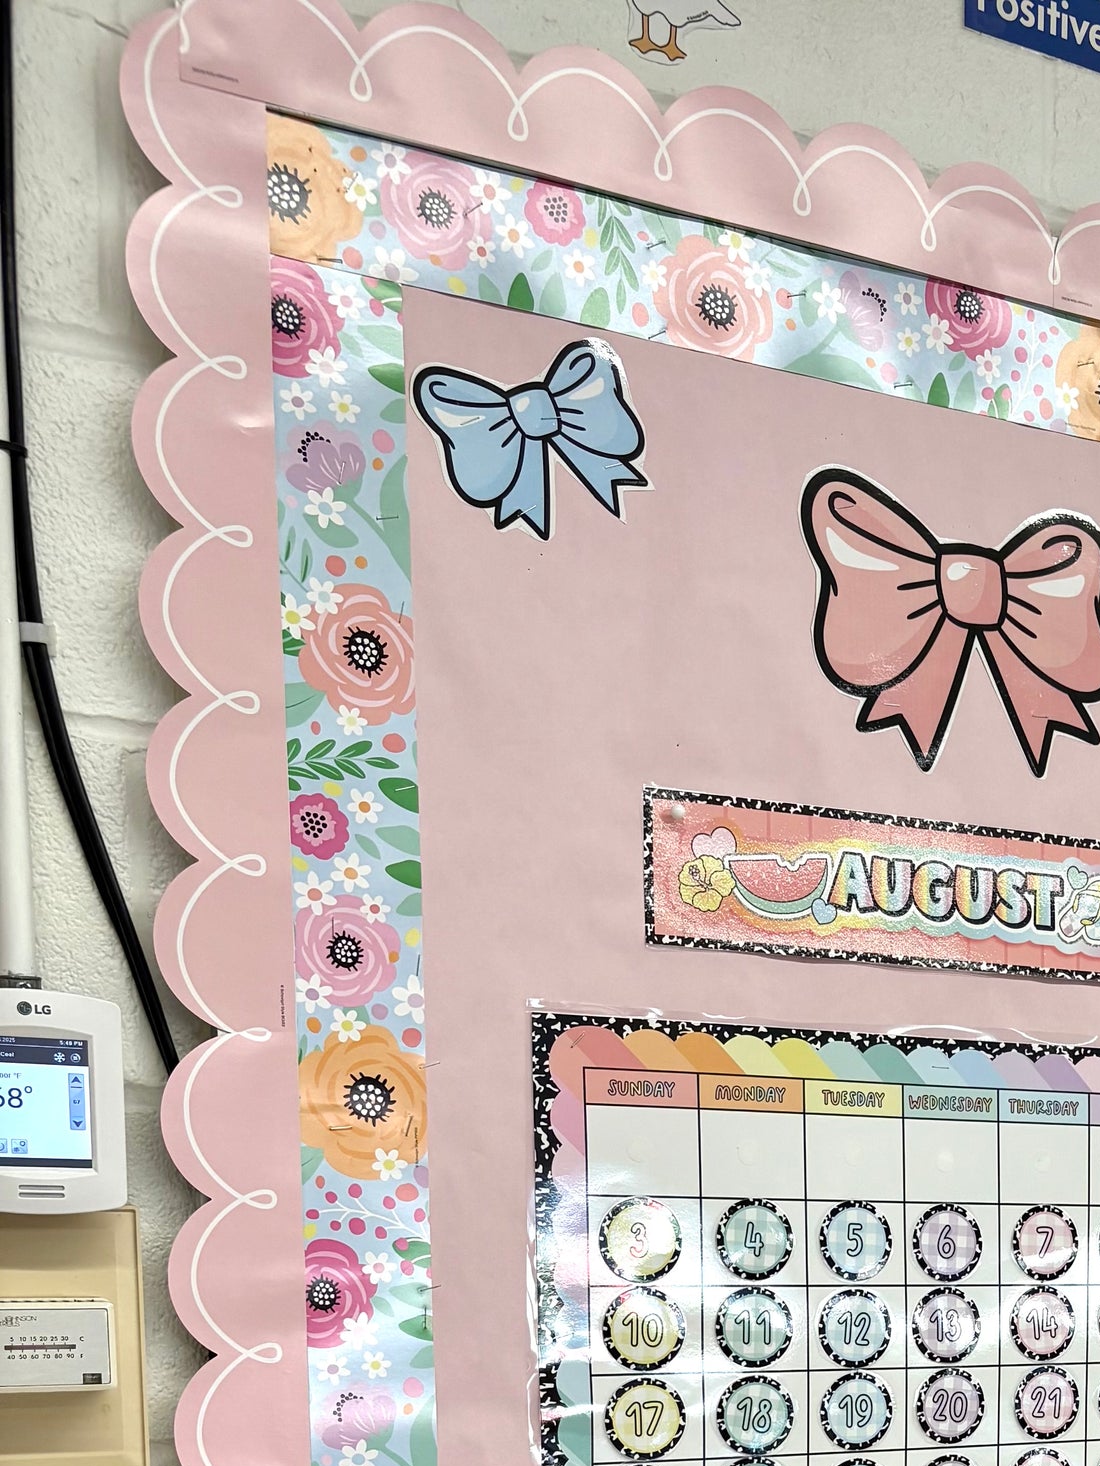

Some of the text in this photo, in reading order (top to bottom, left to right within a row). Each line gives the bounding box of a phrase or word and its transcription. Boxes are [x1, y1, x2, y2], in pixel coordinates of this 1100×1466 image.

[828, 852, 1064, 931] AUGUST
[34, 1004, 52, 1015] LG
[607, 1080, 675, 1098] SUNDAY
[715, 1085, 786, 1103] MONDAY
[822, 1090, 885, 1108] TUESDAY
[909, 1095, 993, 1113] WEDNESDAY
[1008, 1099, 1079, 1116] THURSDAY
[630, 1222, 647, 1258] 3
[744, 1222, 764, 1257] 4
[847, 1223, 863, 1257] 5
[937, 1225, 956, 1259] 6
[1036, 1226, 1053, 1258] 7
[622, 1312, 664, 1347] 10
[734, 1310, 772, 1345] 11
[838, 1311, 871, 1346] 12
[930, 1309, 962, 1342] 13
[1026, 1308, 1058, 1340] 14
[625, 1401, 664, 1437] 17
[737, 1397, 772, 1433] 18
[839, 1394, 873, 1428] 19
[932, 1389, 968, 1422] 20
[1031, 1386, 1062, 1419] 21
